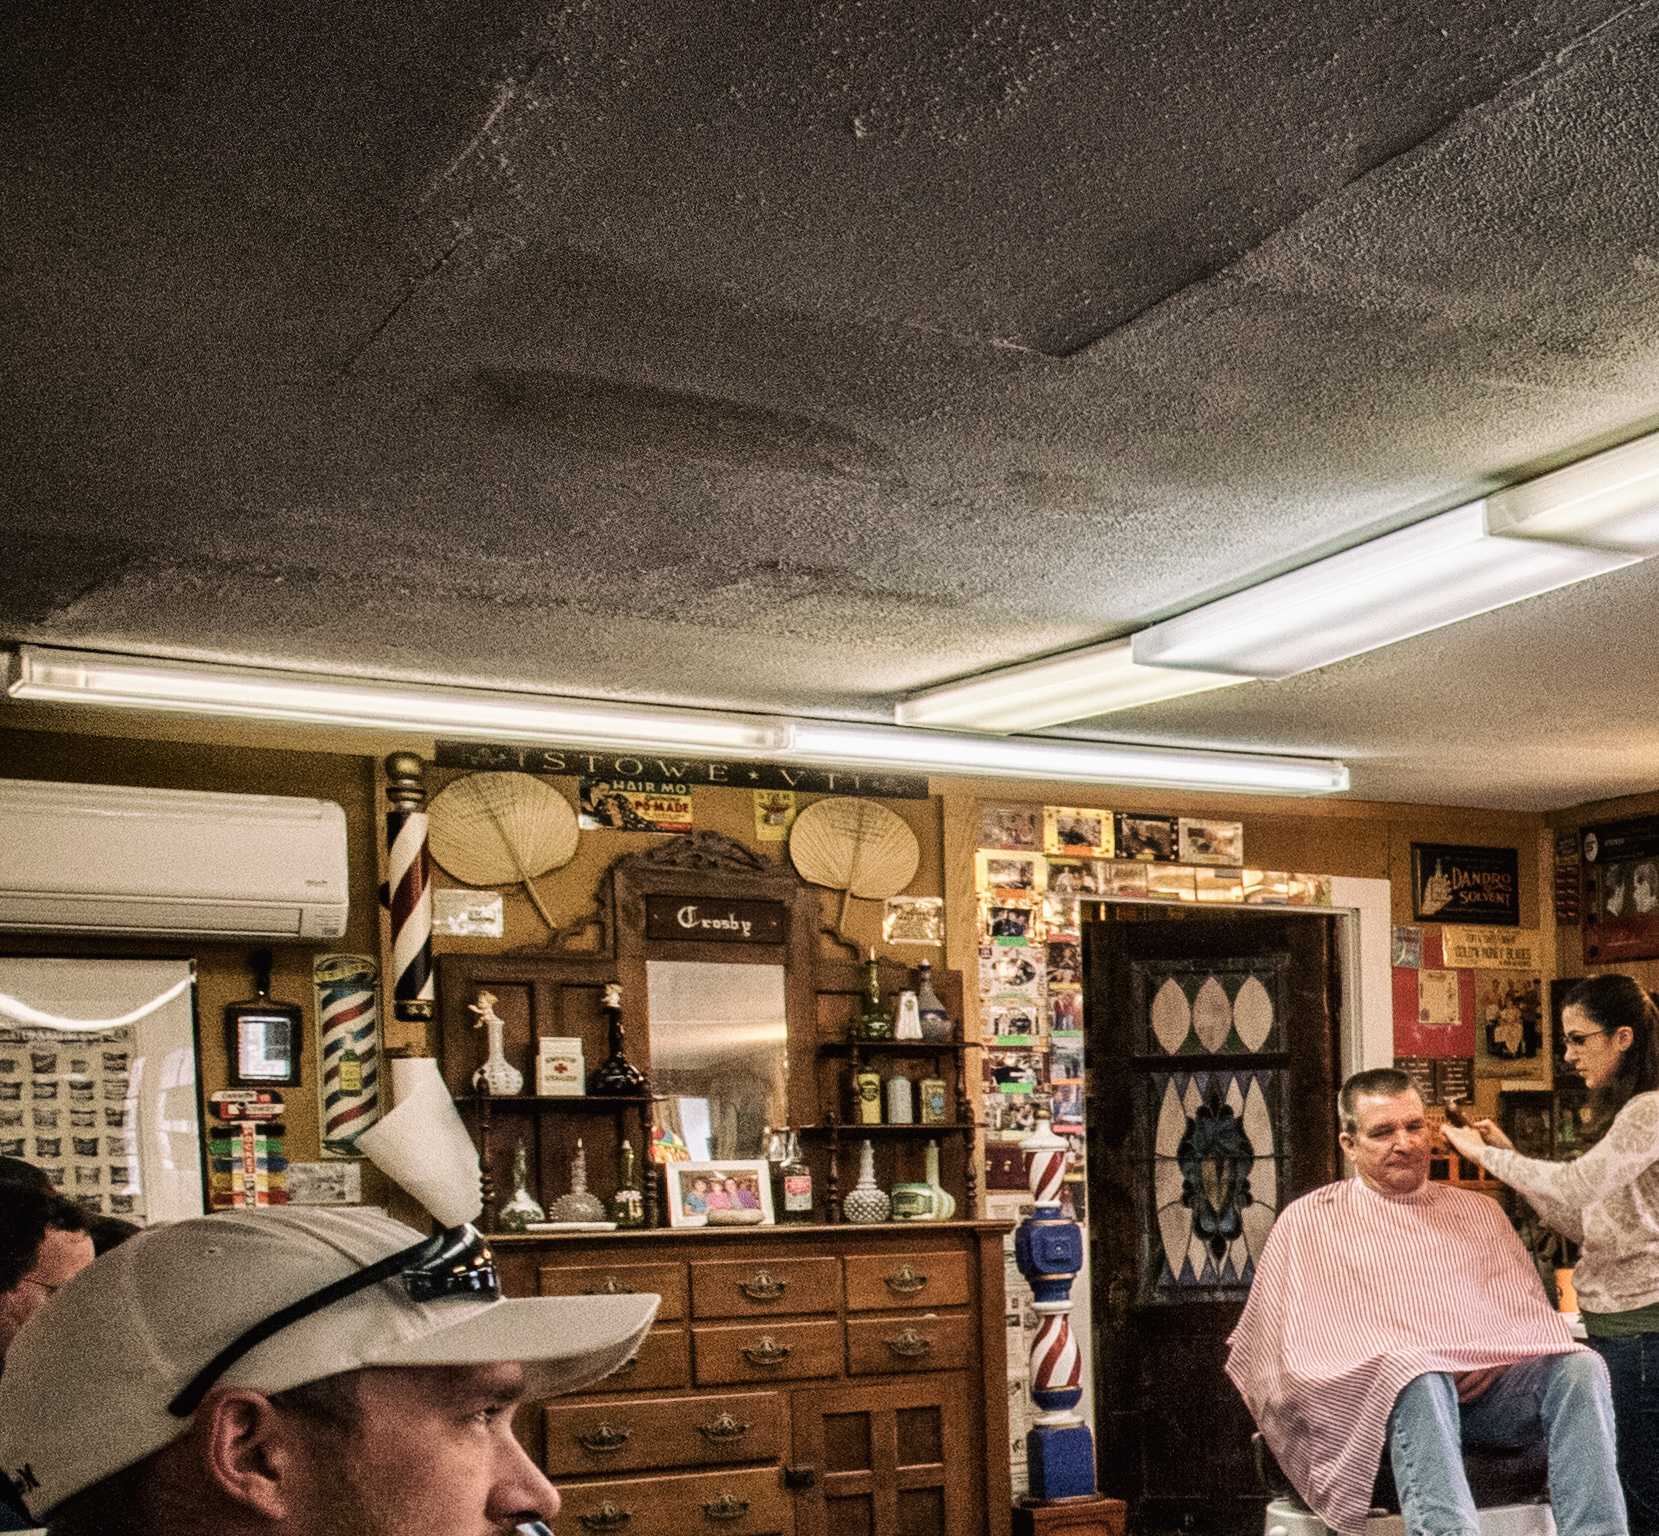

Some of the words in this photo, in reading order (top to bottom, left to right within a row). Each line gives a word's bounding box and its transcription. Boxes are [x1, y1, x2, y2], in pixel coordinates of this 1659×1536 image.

[543, 751, 730, 783] STOWE
[612, 779, 655, 794] HAIR
[1451, 866, 1512, 892] DANDRO
[1458, 889, 1511, 907] SOLVENT
[676, 904, 753, 938] Crosby
